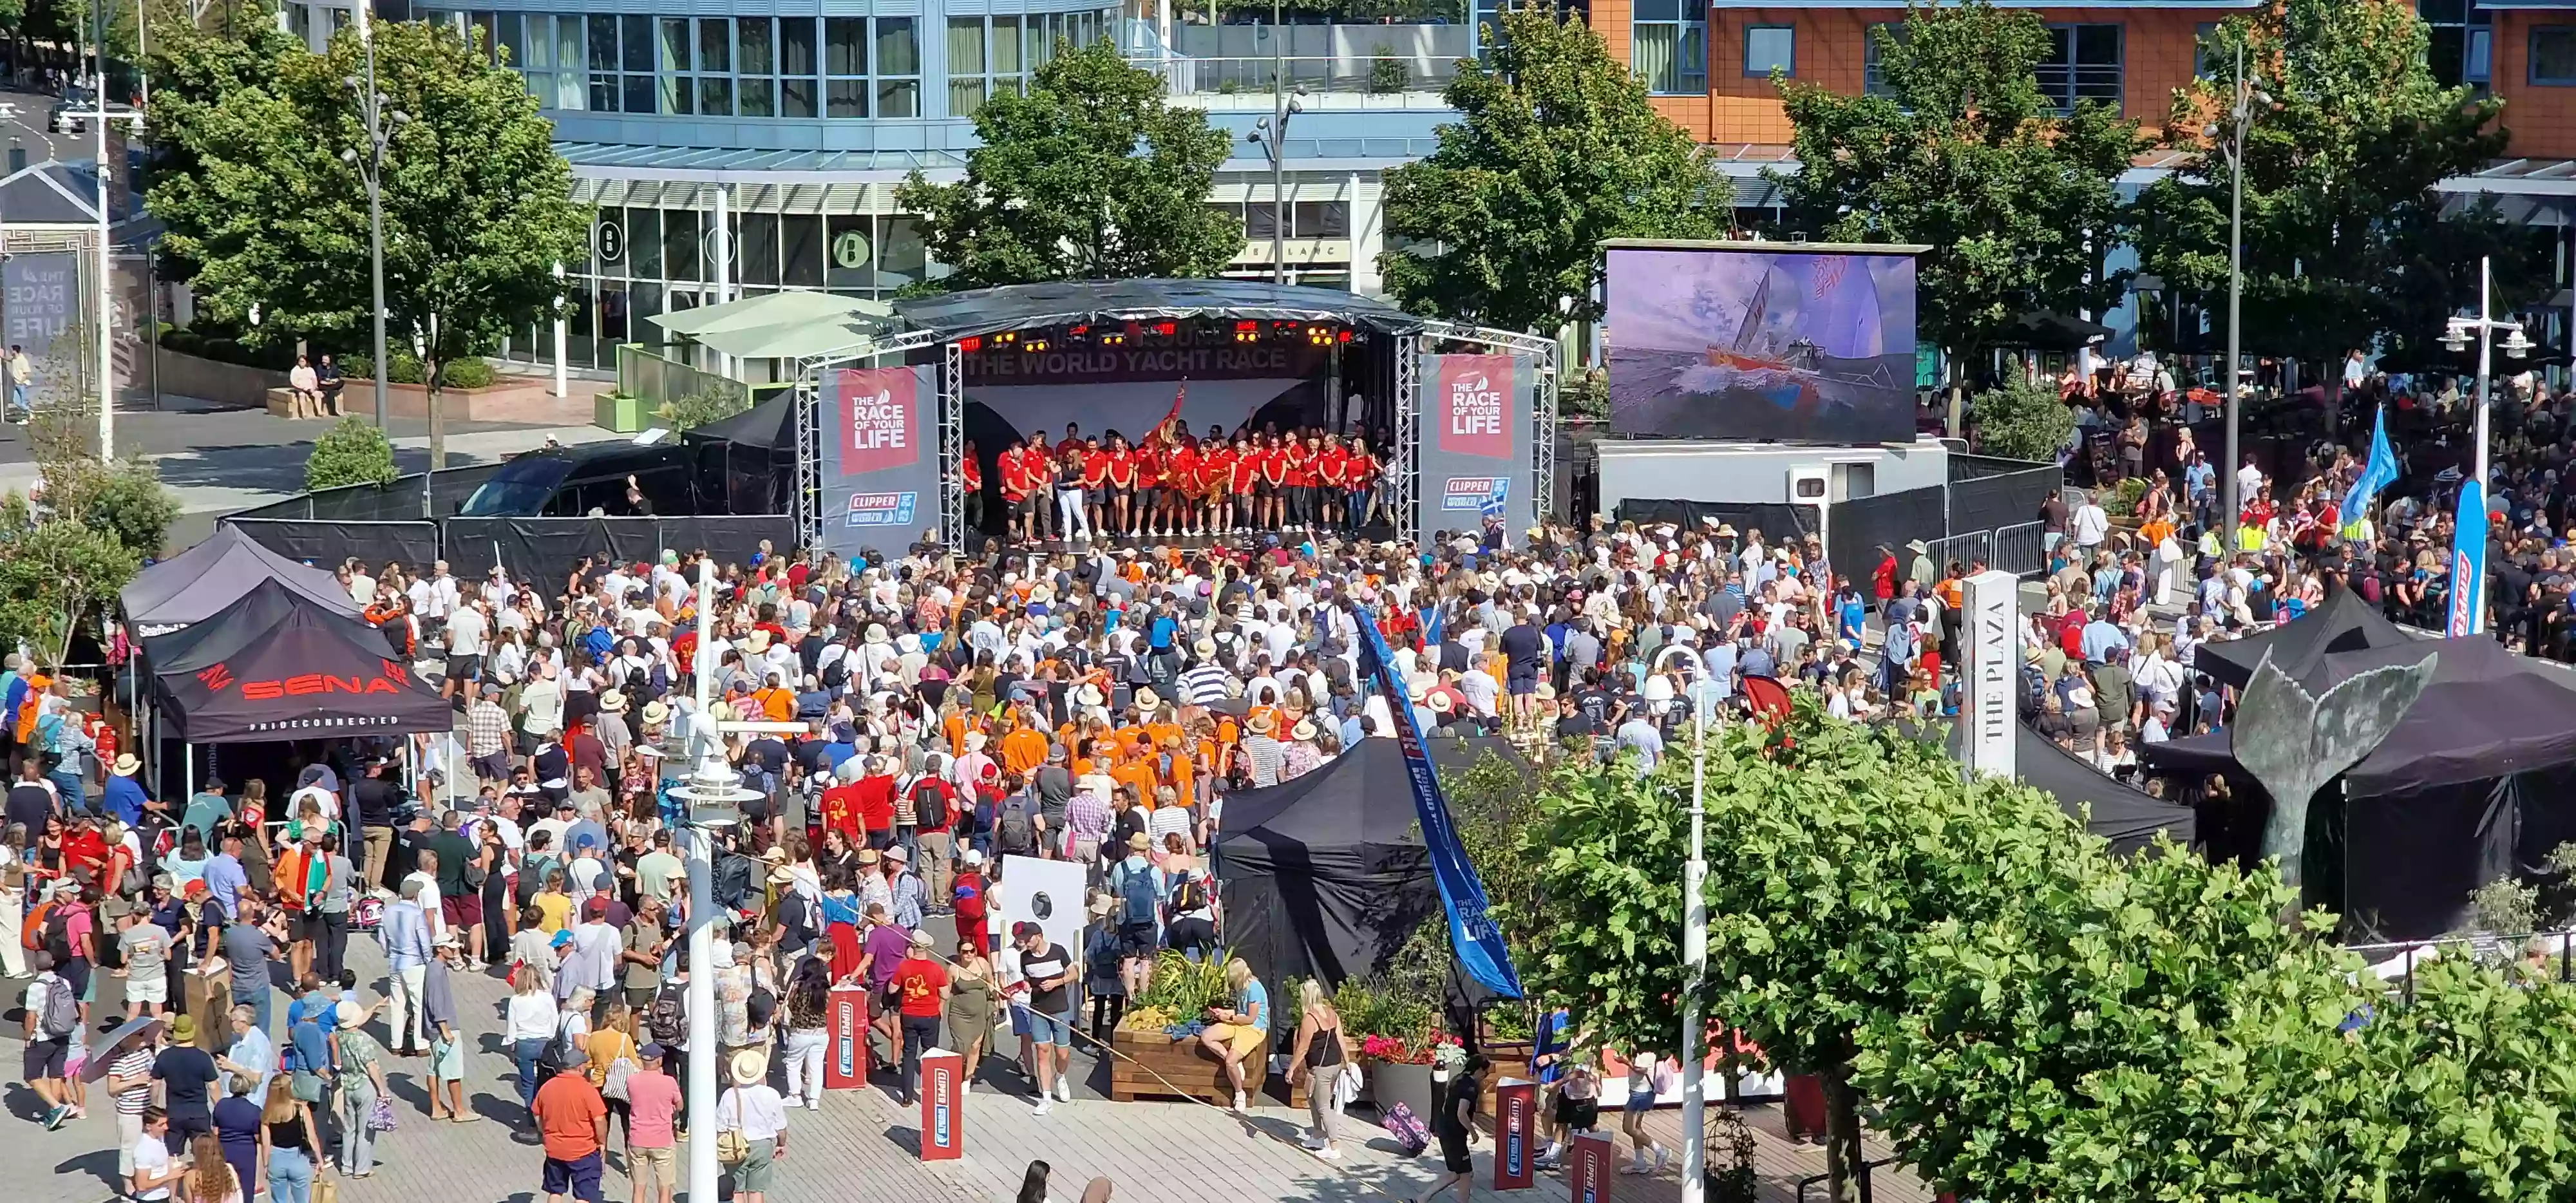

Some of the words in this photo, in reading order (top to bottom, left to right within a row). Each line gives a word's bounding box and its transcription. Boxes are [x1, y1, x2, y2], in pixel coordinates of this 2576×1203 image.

[1288, 247, 1334, 256] LANC
[965, 355, 1016, 376] THE
[1021, 352, 1117, 375] WORLD
[1122, 350, 1212, 372] YACHT
[1217, 347, 1287, 370] RACE
[1451, 383, 1473, 392] THE
[852, 396, 874, 406] THE
[1452, 392, 1501, 406] RACE
[854, 404, 904, 421] RACE
[1453, 406, 1468, 415] OF
[1471, 406, 1501, 415] YOUR
[855, 421, 870, 430] OF
[873, 419, 905, 429] YOUR
[1452, 415, 1501, 434] LIFE
[855, 429, 905, 449] LIFE
[1450, 481, 1490, 491] CLIPPER
[853, 496, 896, 507] CLIPPER
[1985, 601, 2004, 683] PLAZA
[242, 674, 399, 700] SENA
[1985, 692, 2003, 744] THE
[1459, 906, 1482, 919] RA
[1463, 924, 1490, 942] LIF
[1586, 1153, 1595, 1188] CLIPPER
